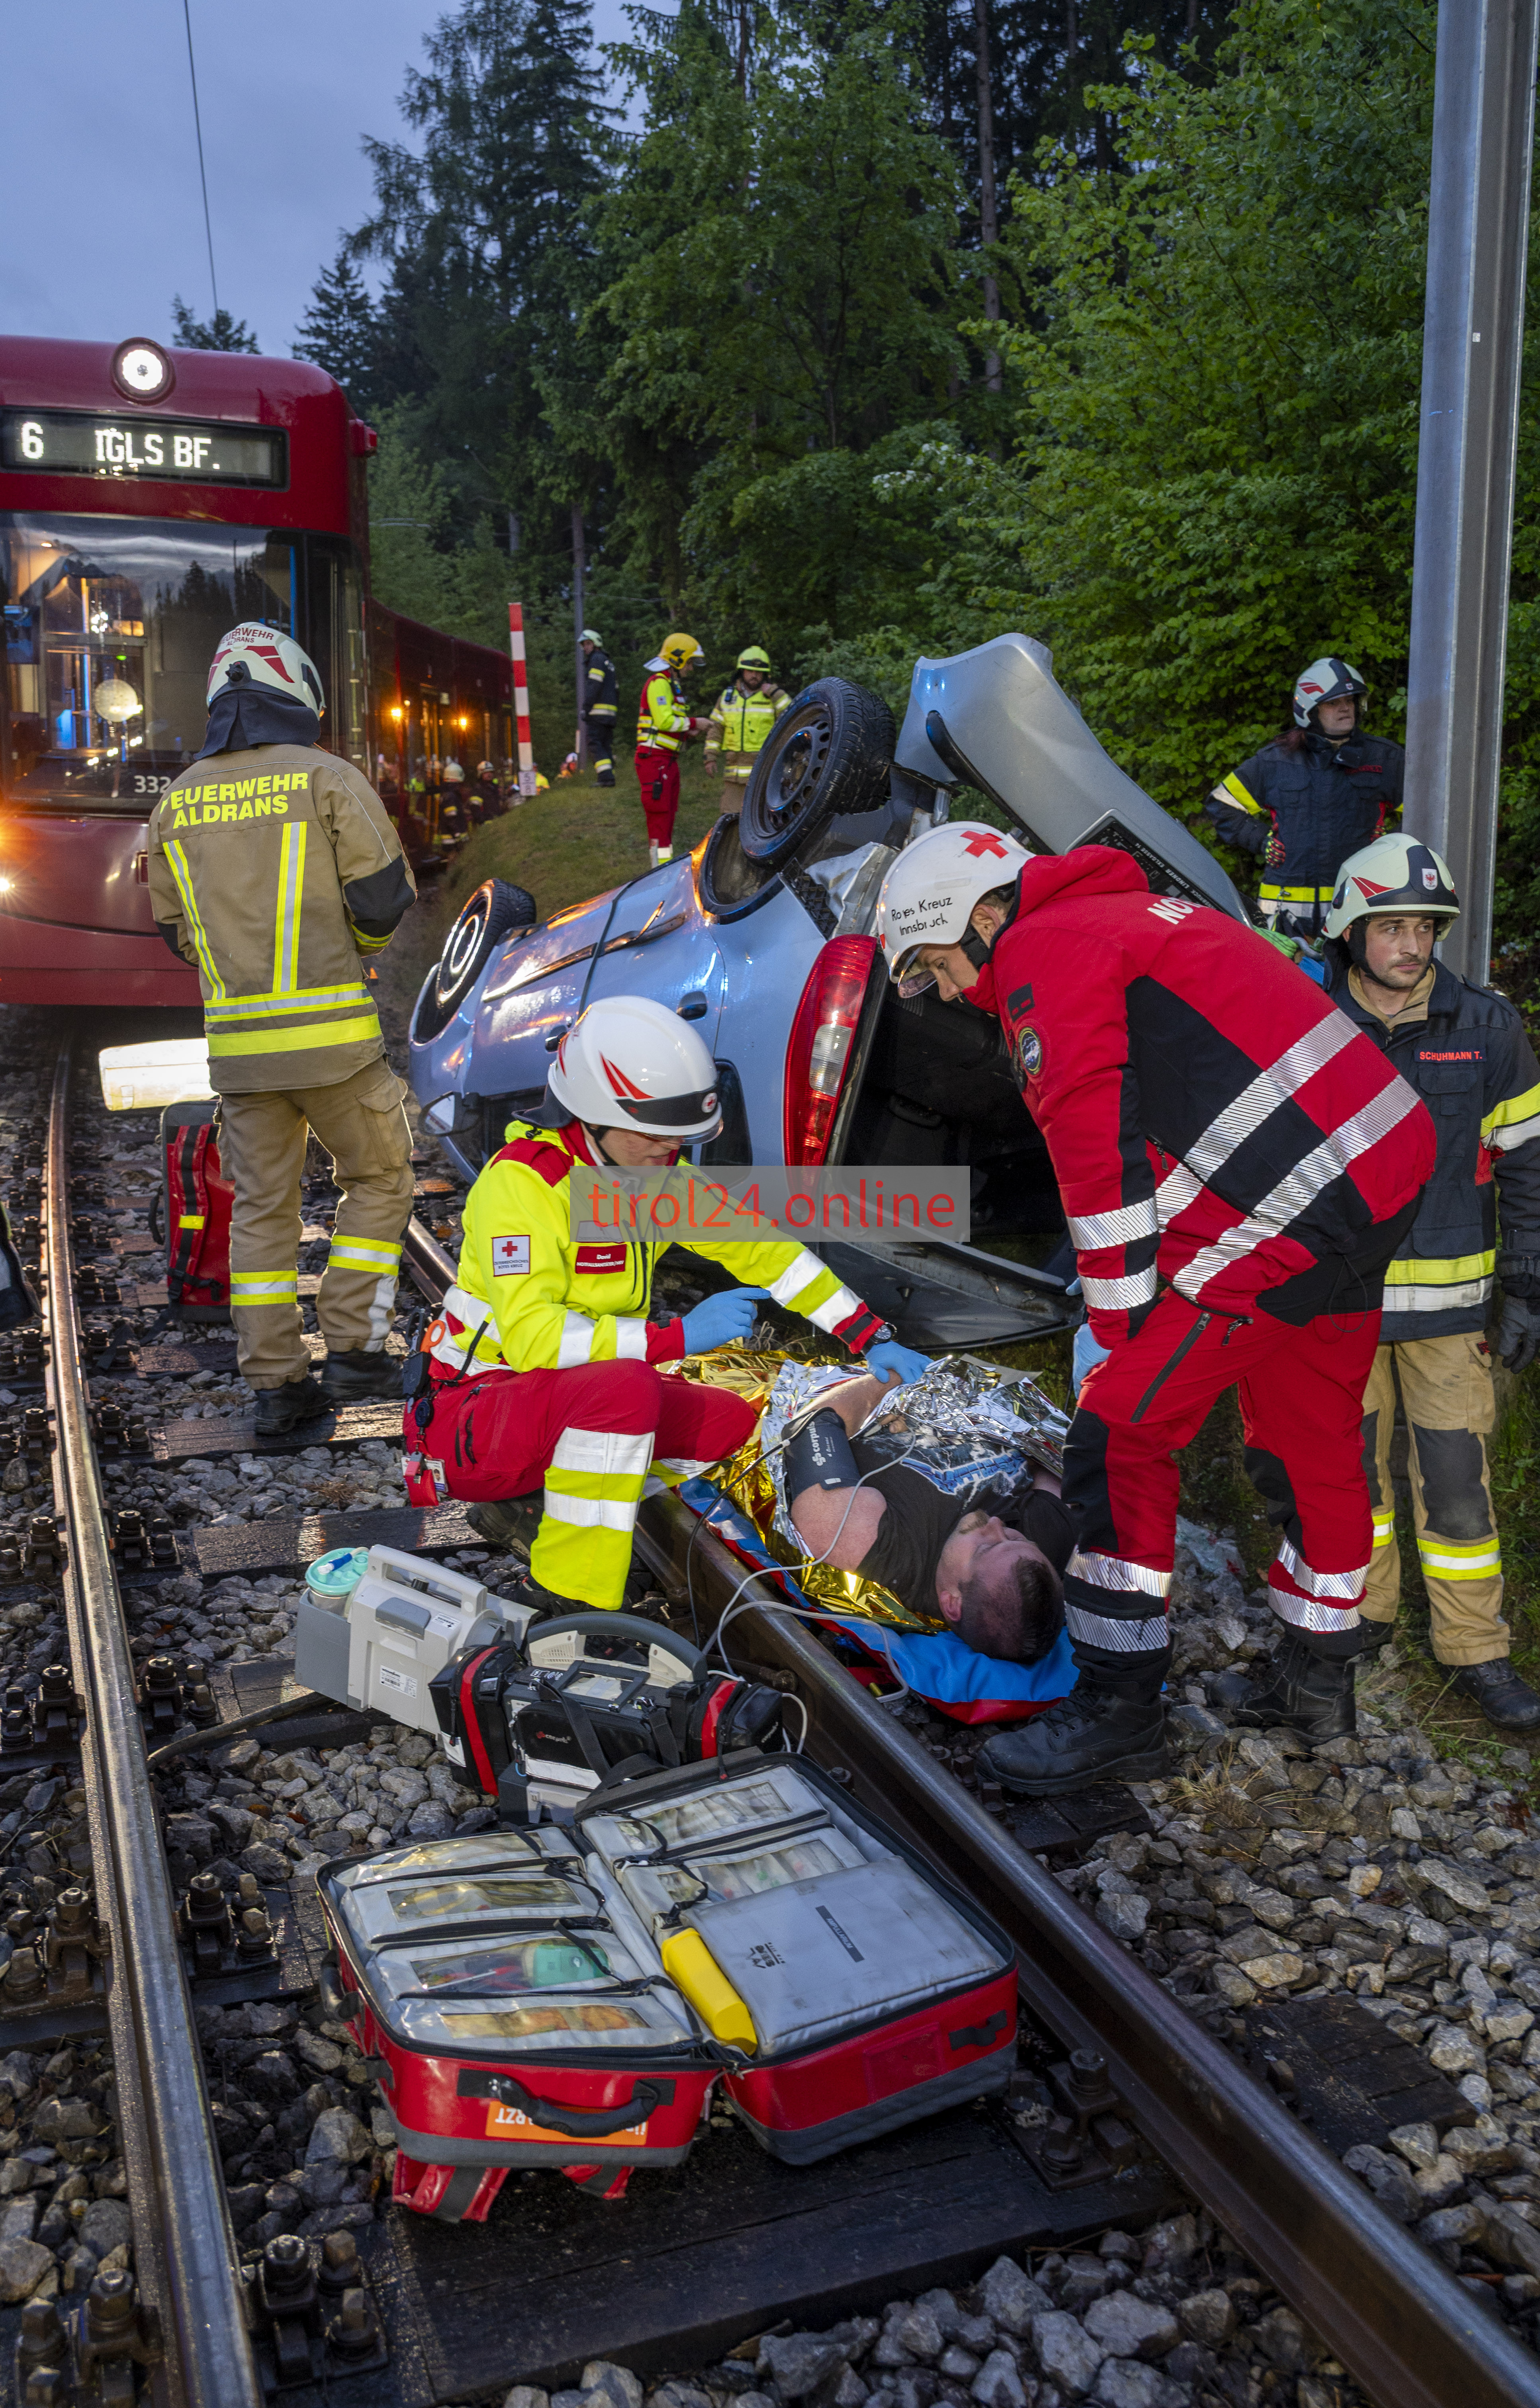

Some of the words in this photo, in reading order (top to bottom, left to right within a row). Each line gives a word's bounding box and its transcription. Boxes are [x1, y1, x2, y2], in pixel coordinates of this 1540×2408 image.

[21, 422, 44, 459] 6
[94, 428, 164, 465] IGLS
[174, 436, 220, 470] BF.
[172, 794, 289, 829] ALDRANS
[1140, 847, 1165, 868] EXLGASSE
[1165, 869, 1190, 889] LINDNER
[918, 897, 953, 913] Kreuz
[1419, 1051, 1472, 1061] SCHUHMANN
[1473, 1051, 1482, 1059] T.
[806, 1421, 820, 1452] corpuls
